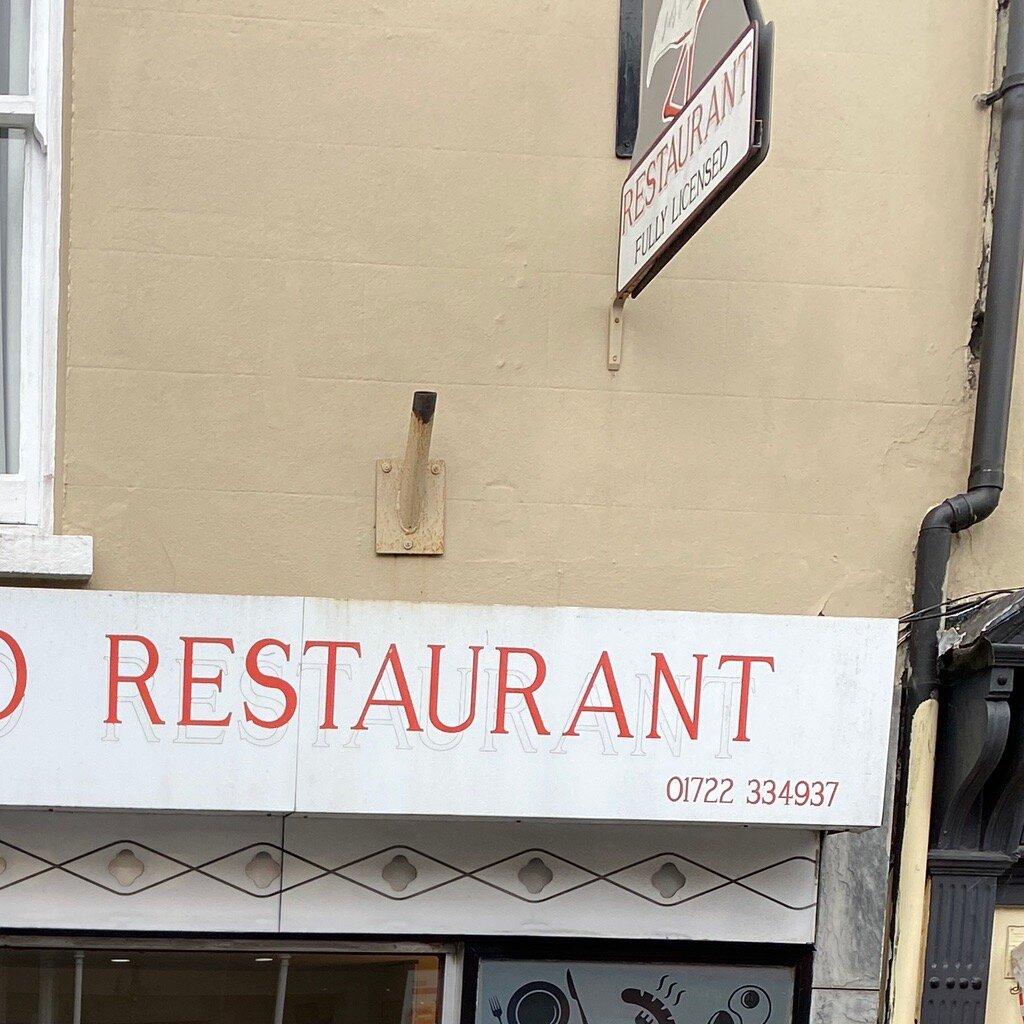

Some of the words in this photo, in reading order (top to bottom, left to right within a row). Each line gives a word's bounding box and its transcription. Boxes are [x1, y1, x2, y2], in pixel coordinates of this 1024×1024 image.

[621, 42, 753, 235] RESTAURANT
[634, 206, 668, 265] FULLY
[671, 140, 729, 225] LICENSED
[104, 634, 776, 742] RESTAURANT
[666, 776, 734, 804] 01722
[746, 779, 839, 807] 334937
